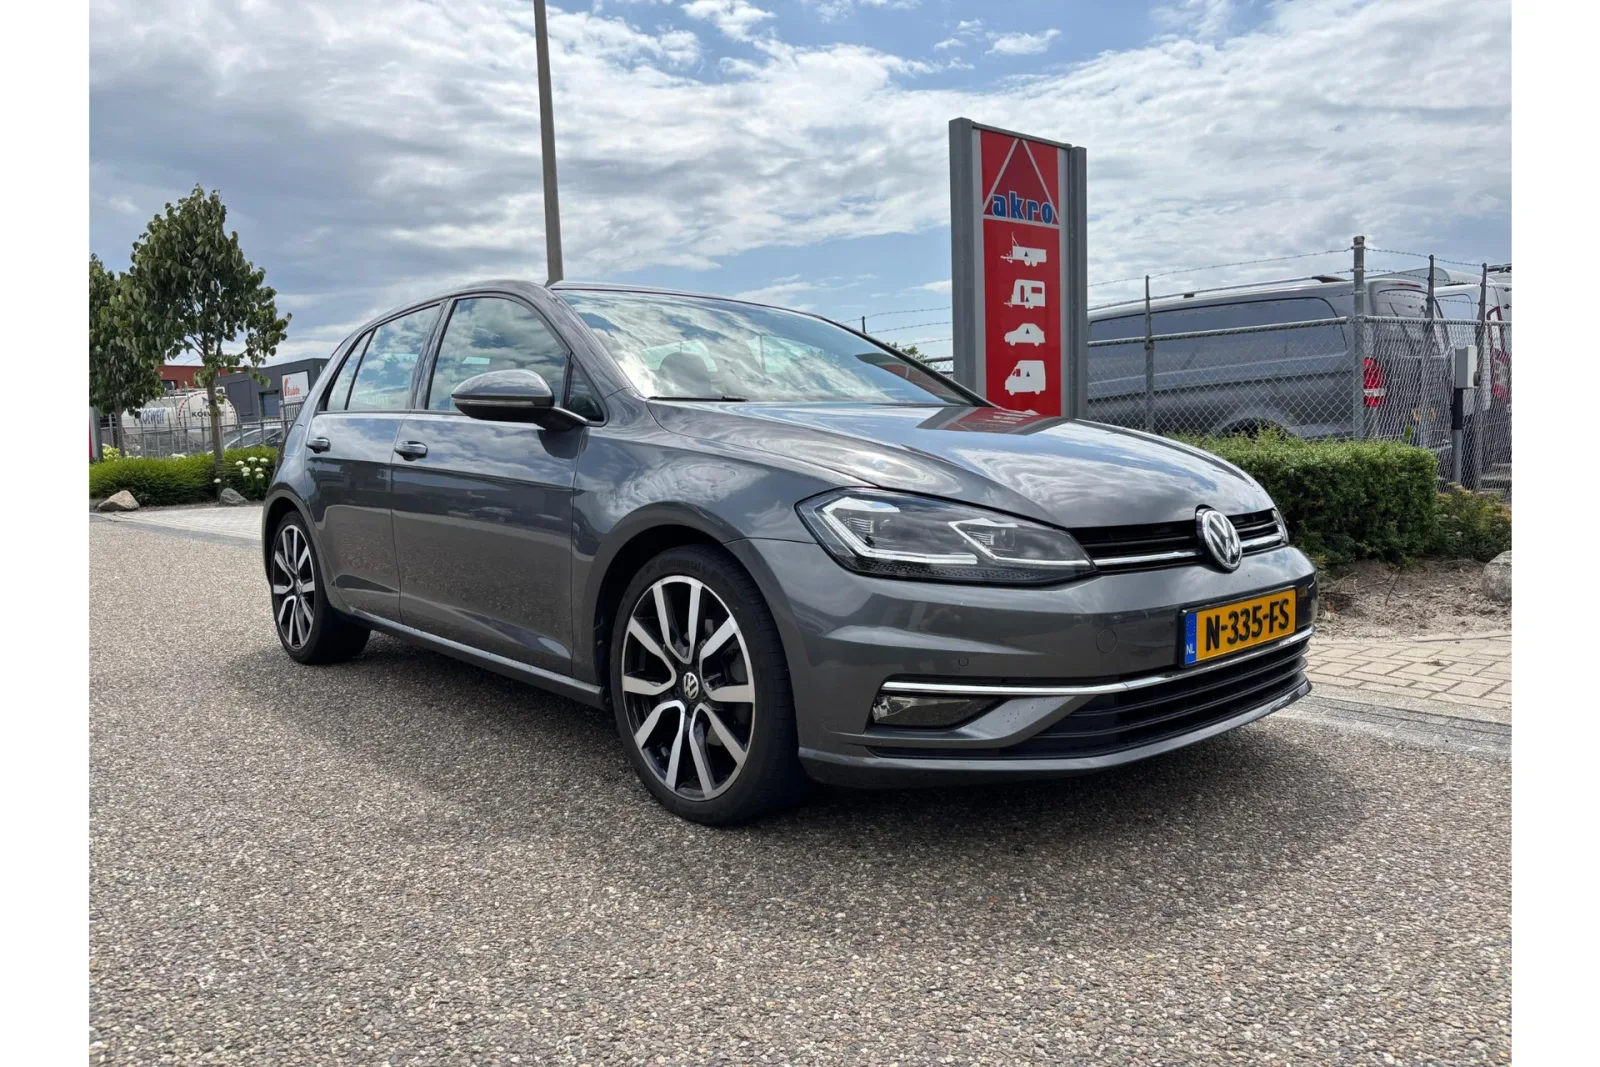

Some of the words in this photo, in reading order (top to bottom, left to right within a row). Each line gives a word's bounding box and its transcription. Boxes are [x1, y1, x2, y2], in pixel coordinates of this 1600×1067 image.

[992, 190, 1054, 224] akro
[1206, 598, 1290, 651] N-335-FS
[1186, 643, 1195, 655] NL
